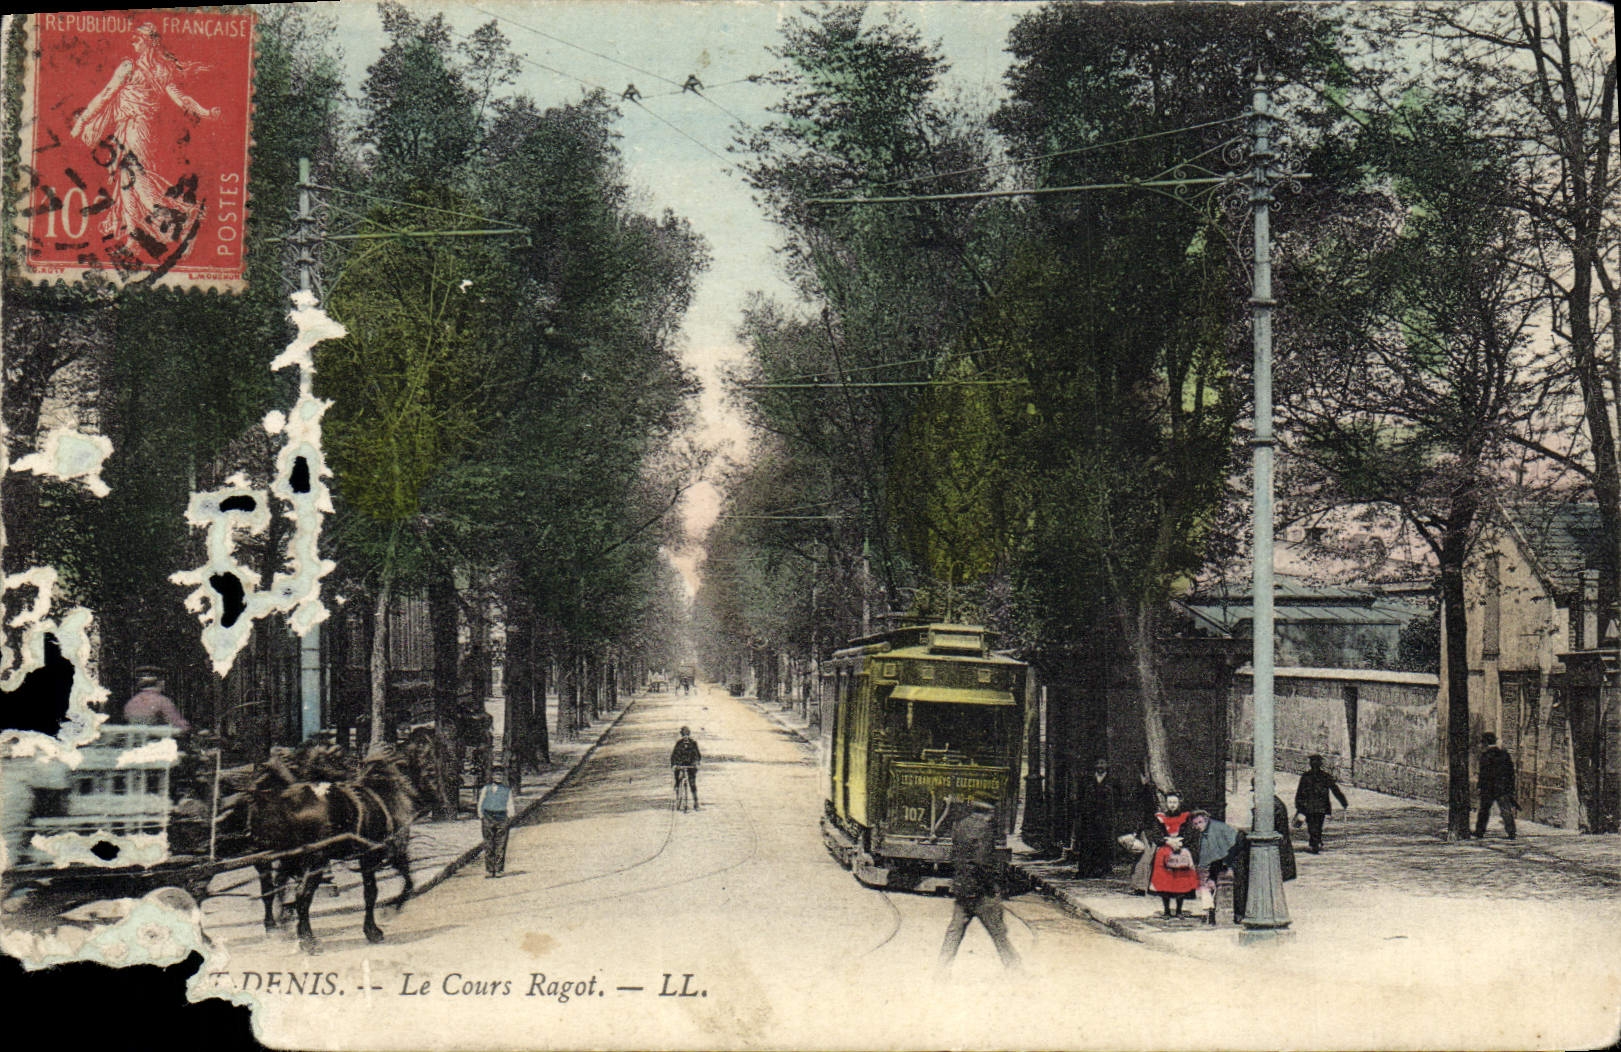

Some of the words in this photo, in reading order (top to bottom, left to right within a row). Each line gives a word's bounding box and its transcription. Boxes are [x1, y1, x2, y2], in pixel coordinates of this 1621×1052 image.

[163, 16, 248, 38] FRANÇAISE
[40, 187, 89, 239] 10
[217, 173, 239, 256] POSTES
